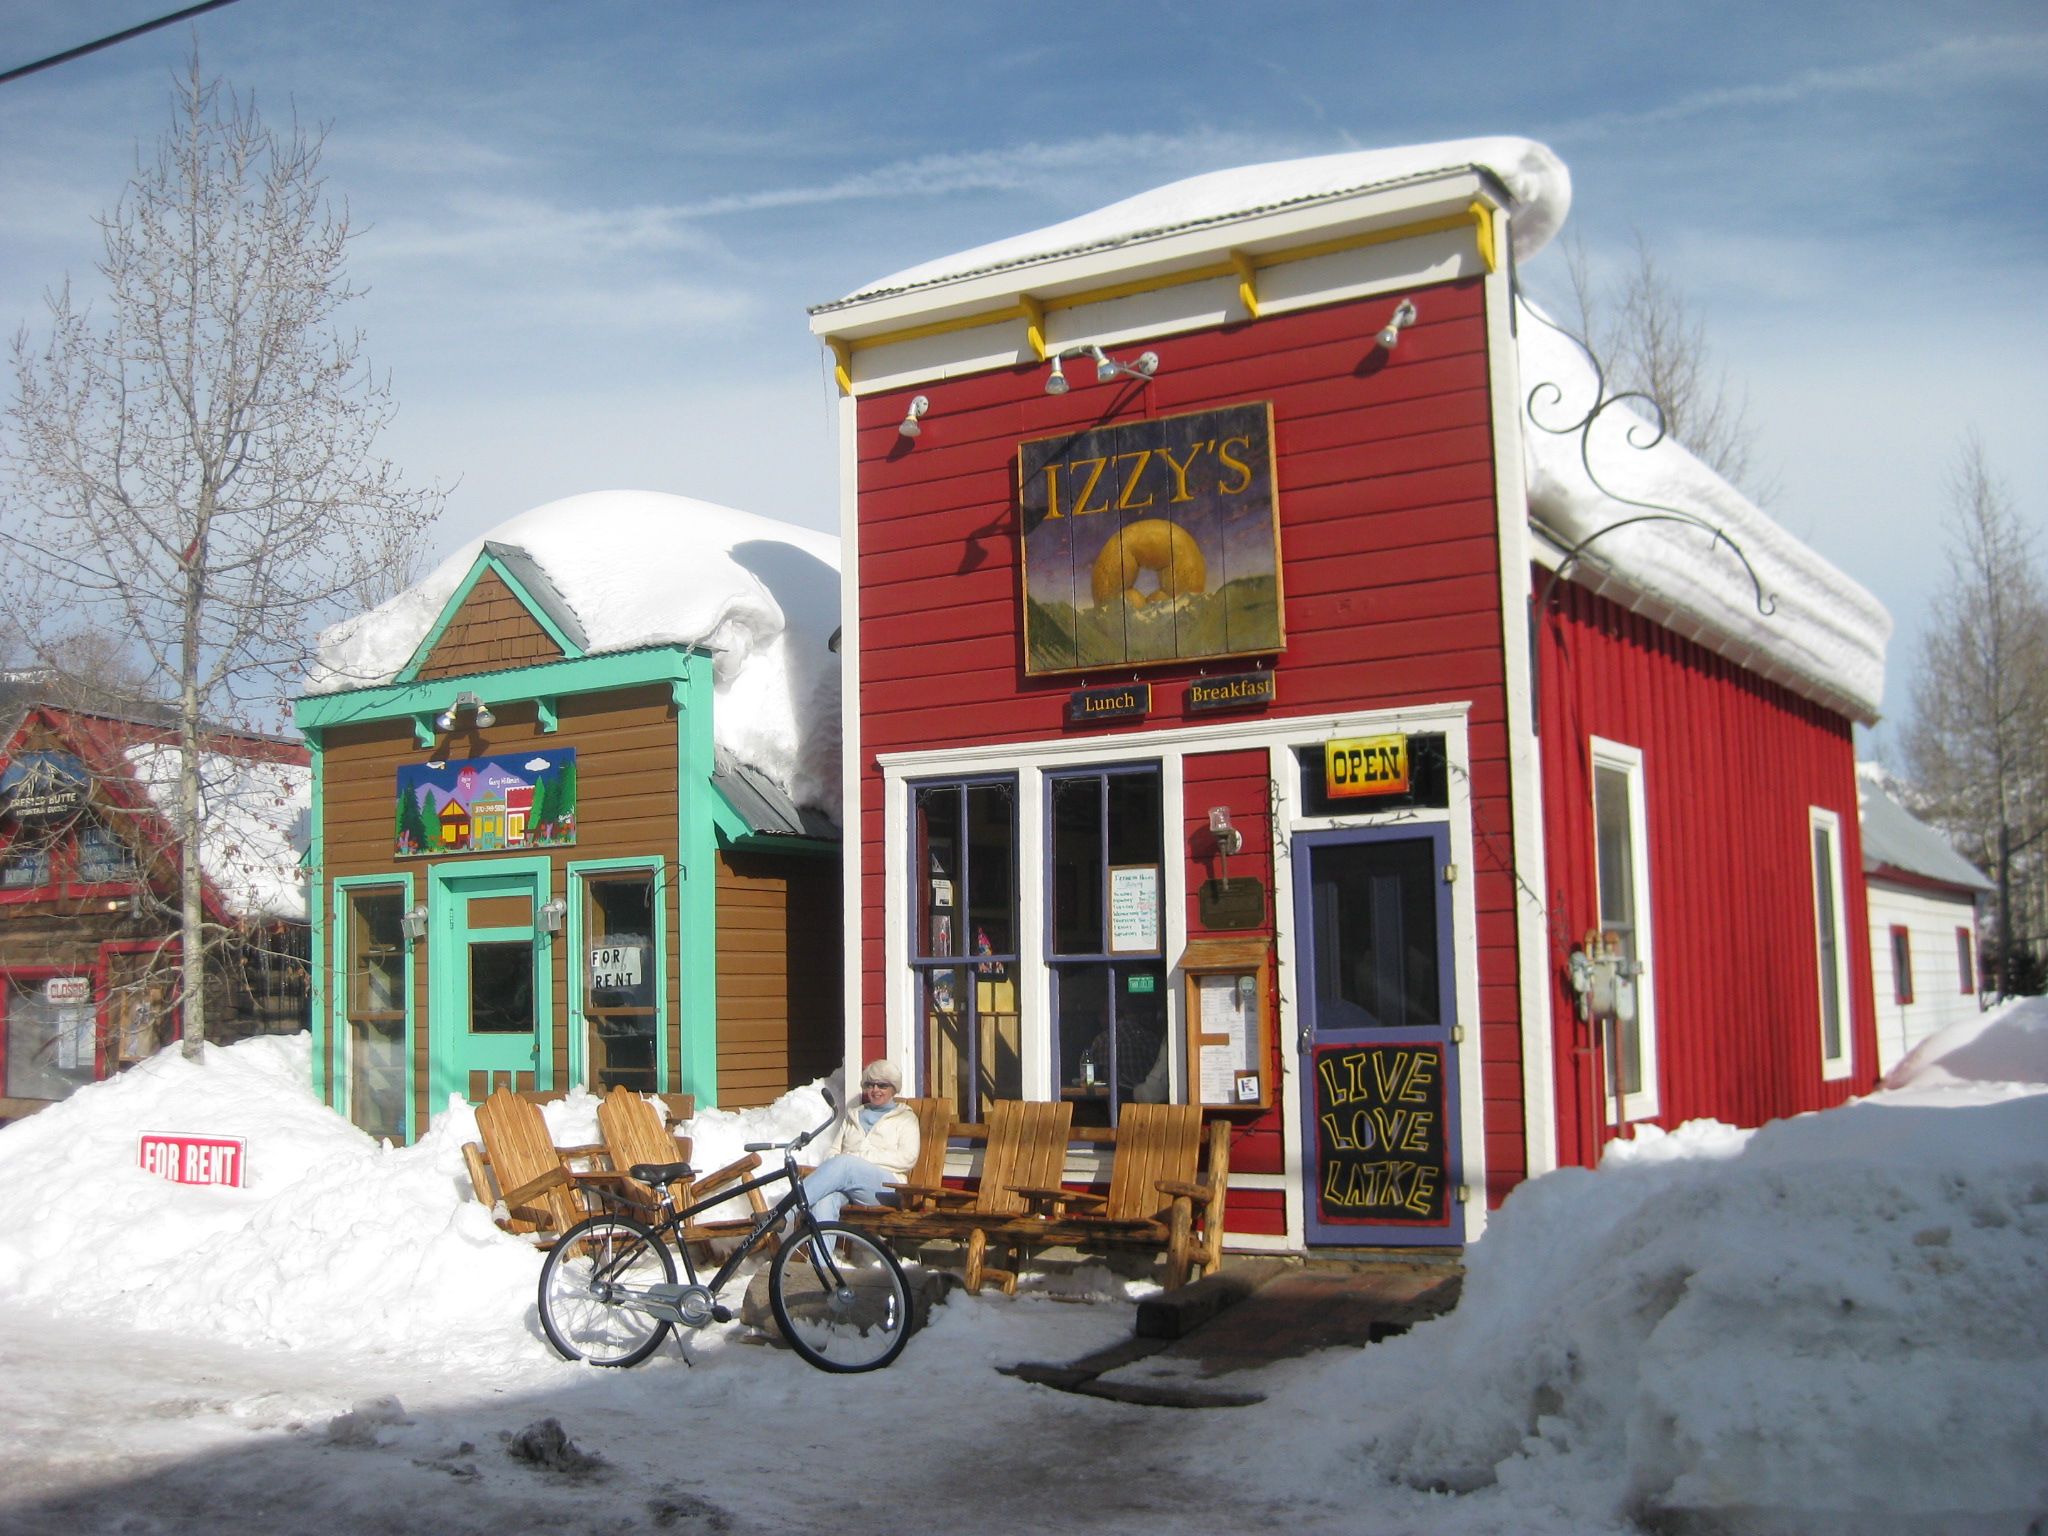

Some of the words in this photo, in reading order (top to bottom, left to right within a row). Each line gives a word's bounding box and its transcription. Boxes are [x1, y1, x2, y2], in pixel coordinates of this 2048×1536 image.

[1042, 435, 1252, 519] IZZY'S
[1085, 692, 1135, 712] Lunch
[1191, 679, 1272, 702] Breakfast
[1333, 745, 1401, 785] OPEN
[48, 792, 77, 804] BUTTE
[591, 949, 621, 967] FOR
[595, 972, 633, 989] RENT
[1318, 1050, 1438, 1107] LIVE
[1321, 1107, 1434, 1152] LOVE
[145, 1141, 181, 1181] FOR
[185, 1144, 237, 1184] RENT
[1323, 1160, 1440, 1216] LATKE
